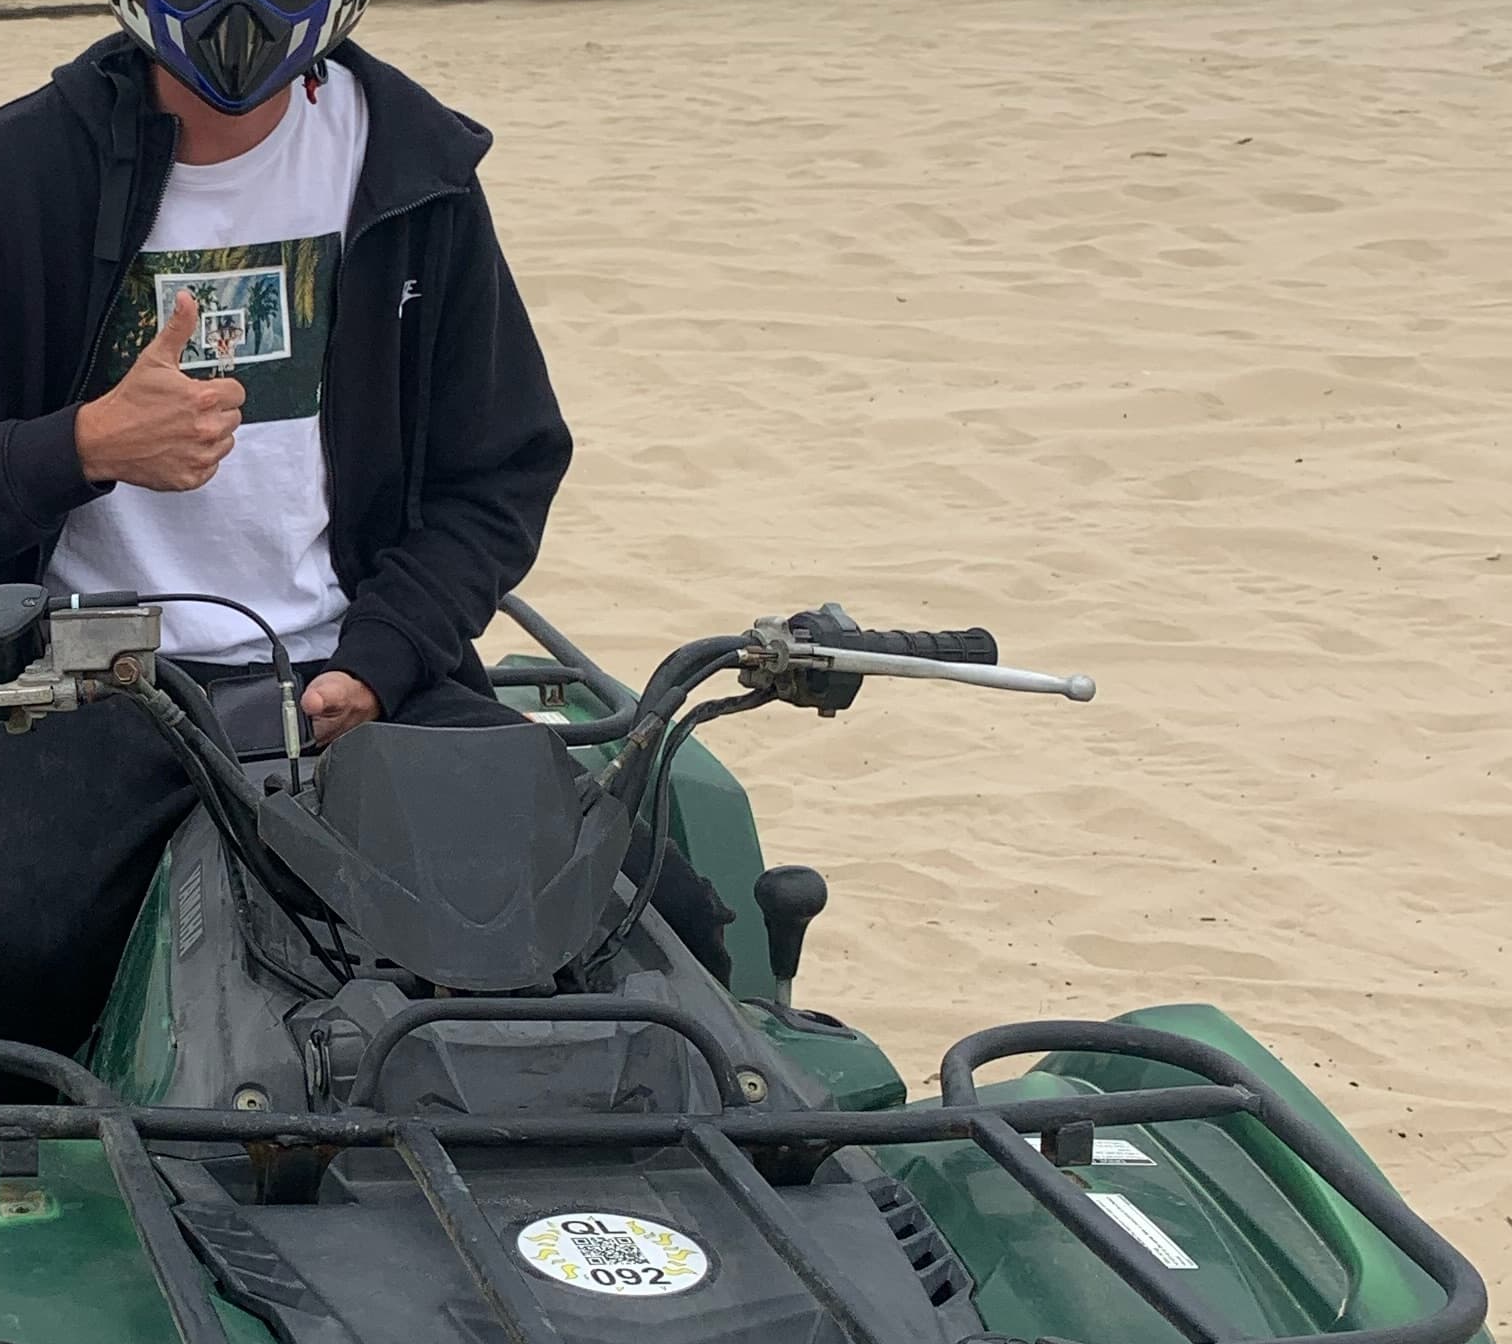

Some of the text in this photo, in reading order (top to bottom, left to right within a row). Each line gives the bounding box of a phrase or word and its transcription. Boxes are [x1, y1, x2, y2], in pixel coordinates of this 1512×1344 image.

[178, 863, 203, 957] YAMAHA
[561, 1220, 627, 1236] QL
[590, 1267, 672, 1286] 092
